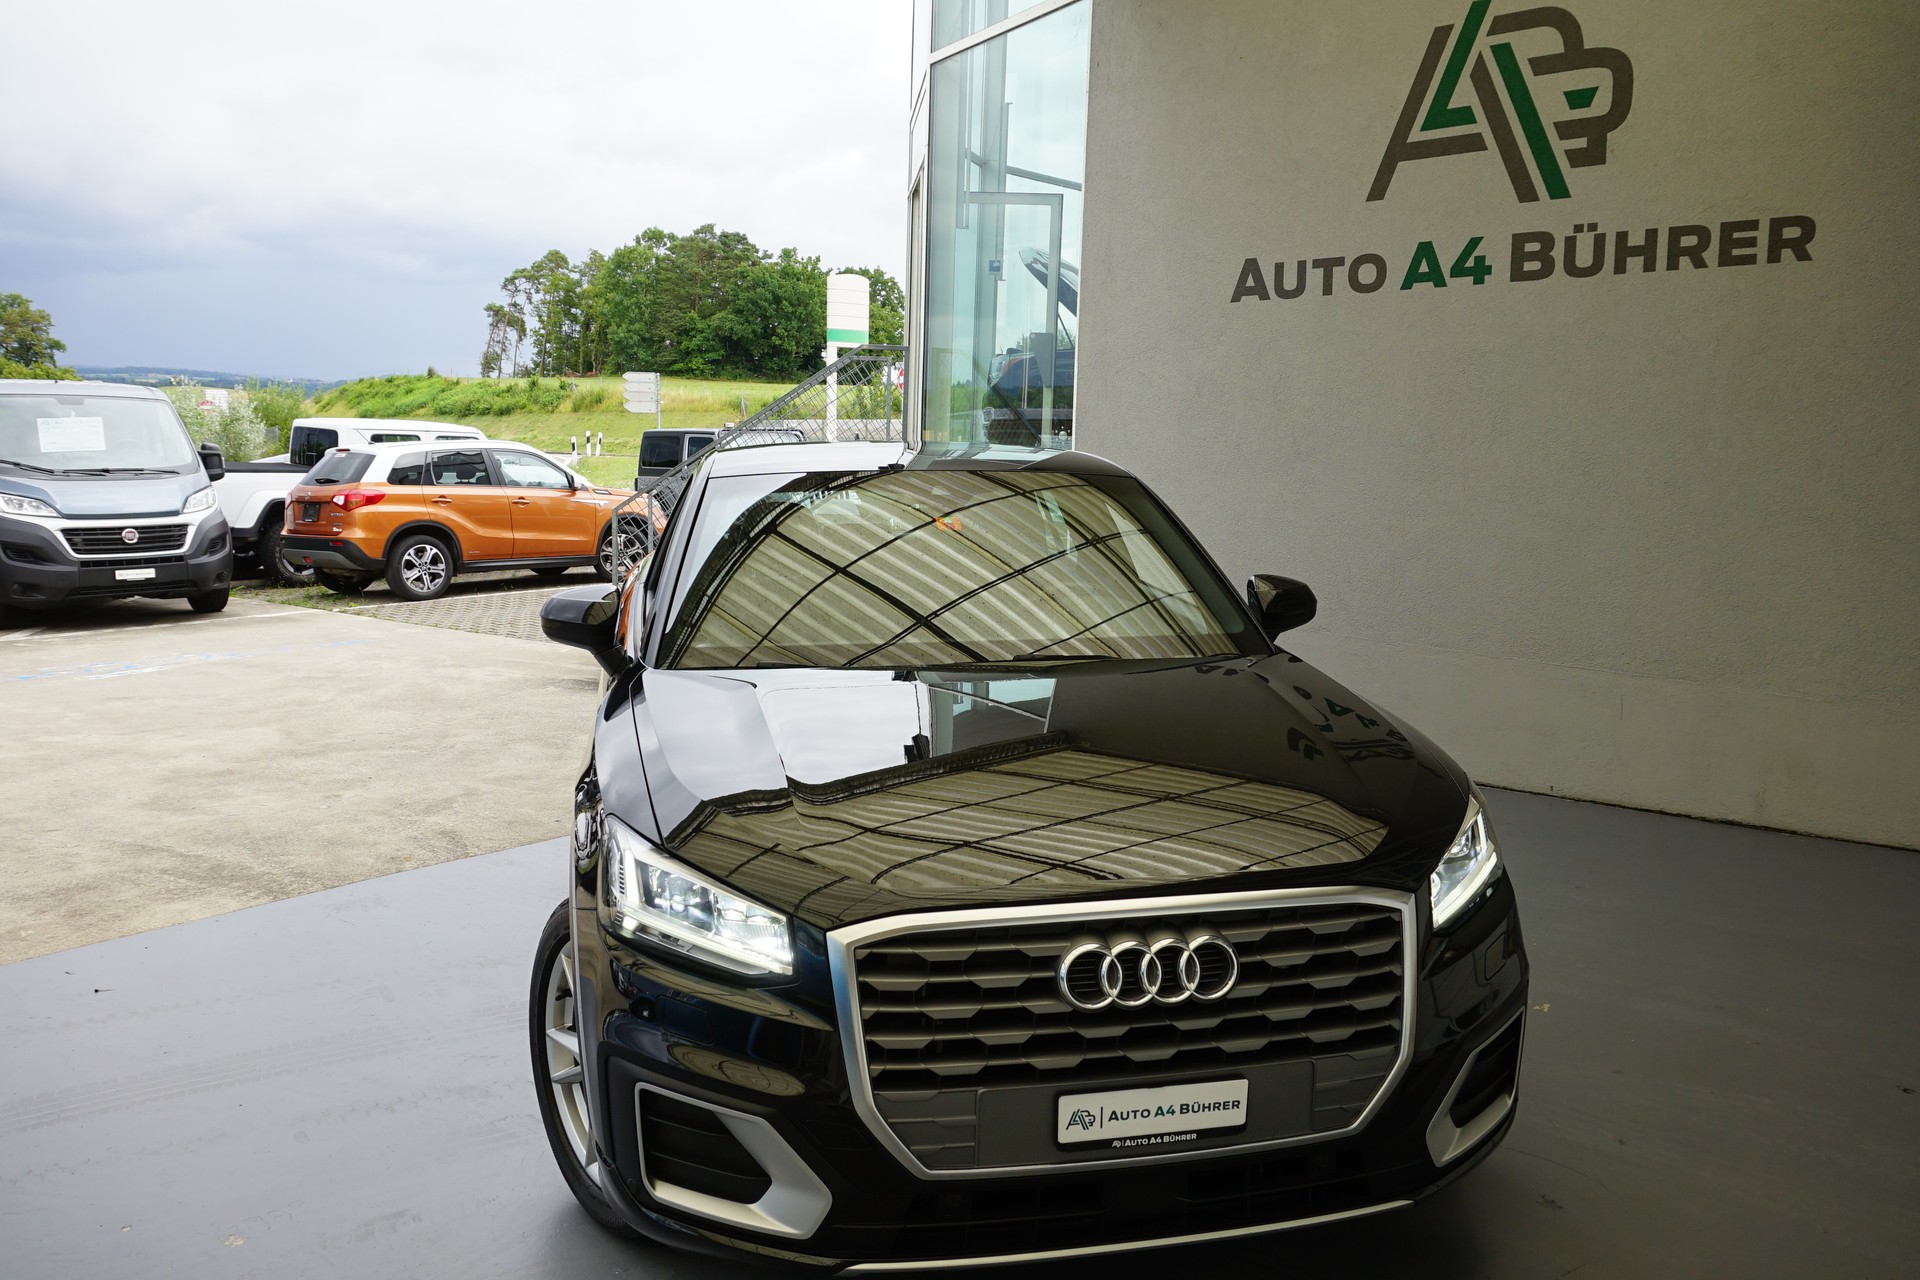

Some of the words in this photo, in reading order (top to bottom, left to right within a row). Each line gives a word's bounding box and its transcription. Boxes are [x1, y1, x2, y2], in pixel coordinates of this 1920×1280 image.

[1230, 253, 1388, 303] AUTO
[1400, 236, 1492, 291] A4
[1509, 215, 1817, 283] BÜHRER
[1108, 1109, 1151, 1122] AUTO
[1154, 1105, 1176, 1117] A4
[1180, 1100, 1241, 1114] BÜHRER
[1125, 1138, 1149, 1146] AUTO
[1150, 1136, 1162, 1144] A4
[1164, 1133, 1197, 1142] BÜHRER
